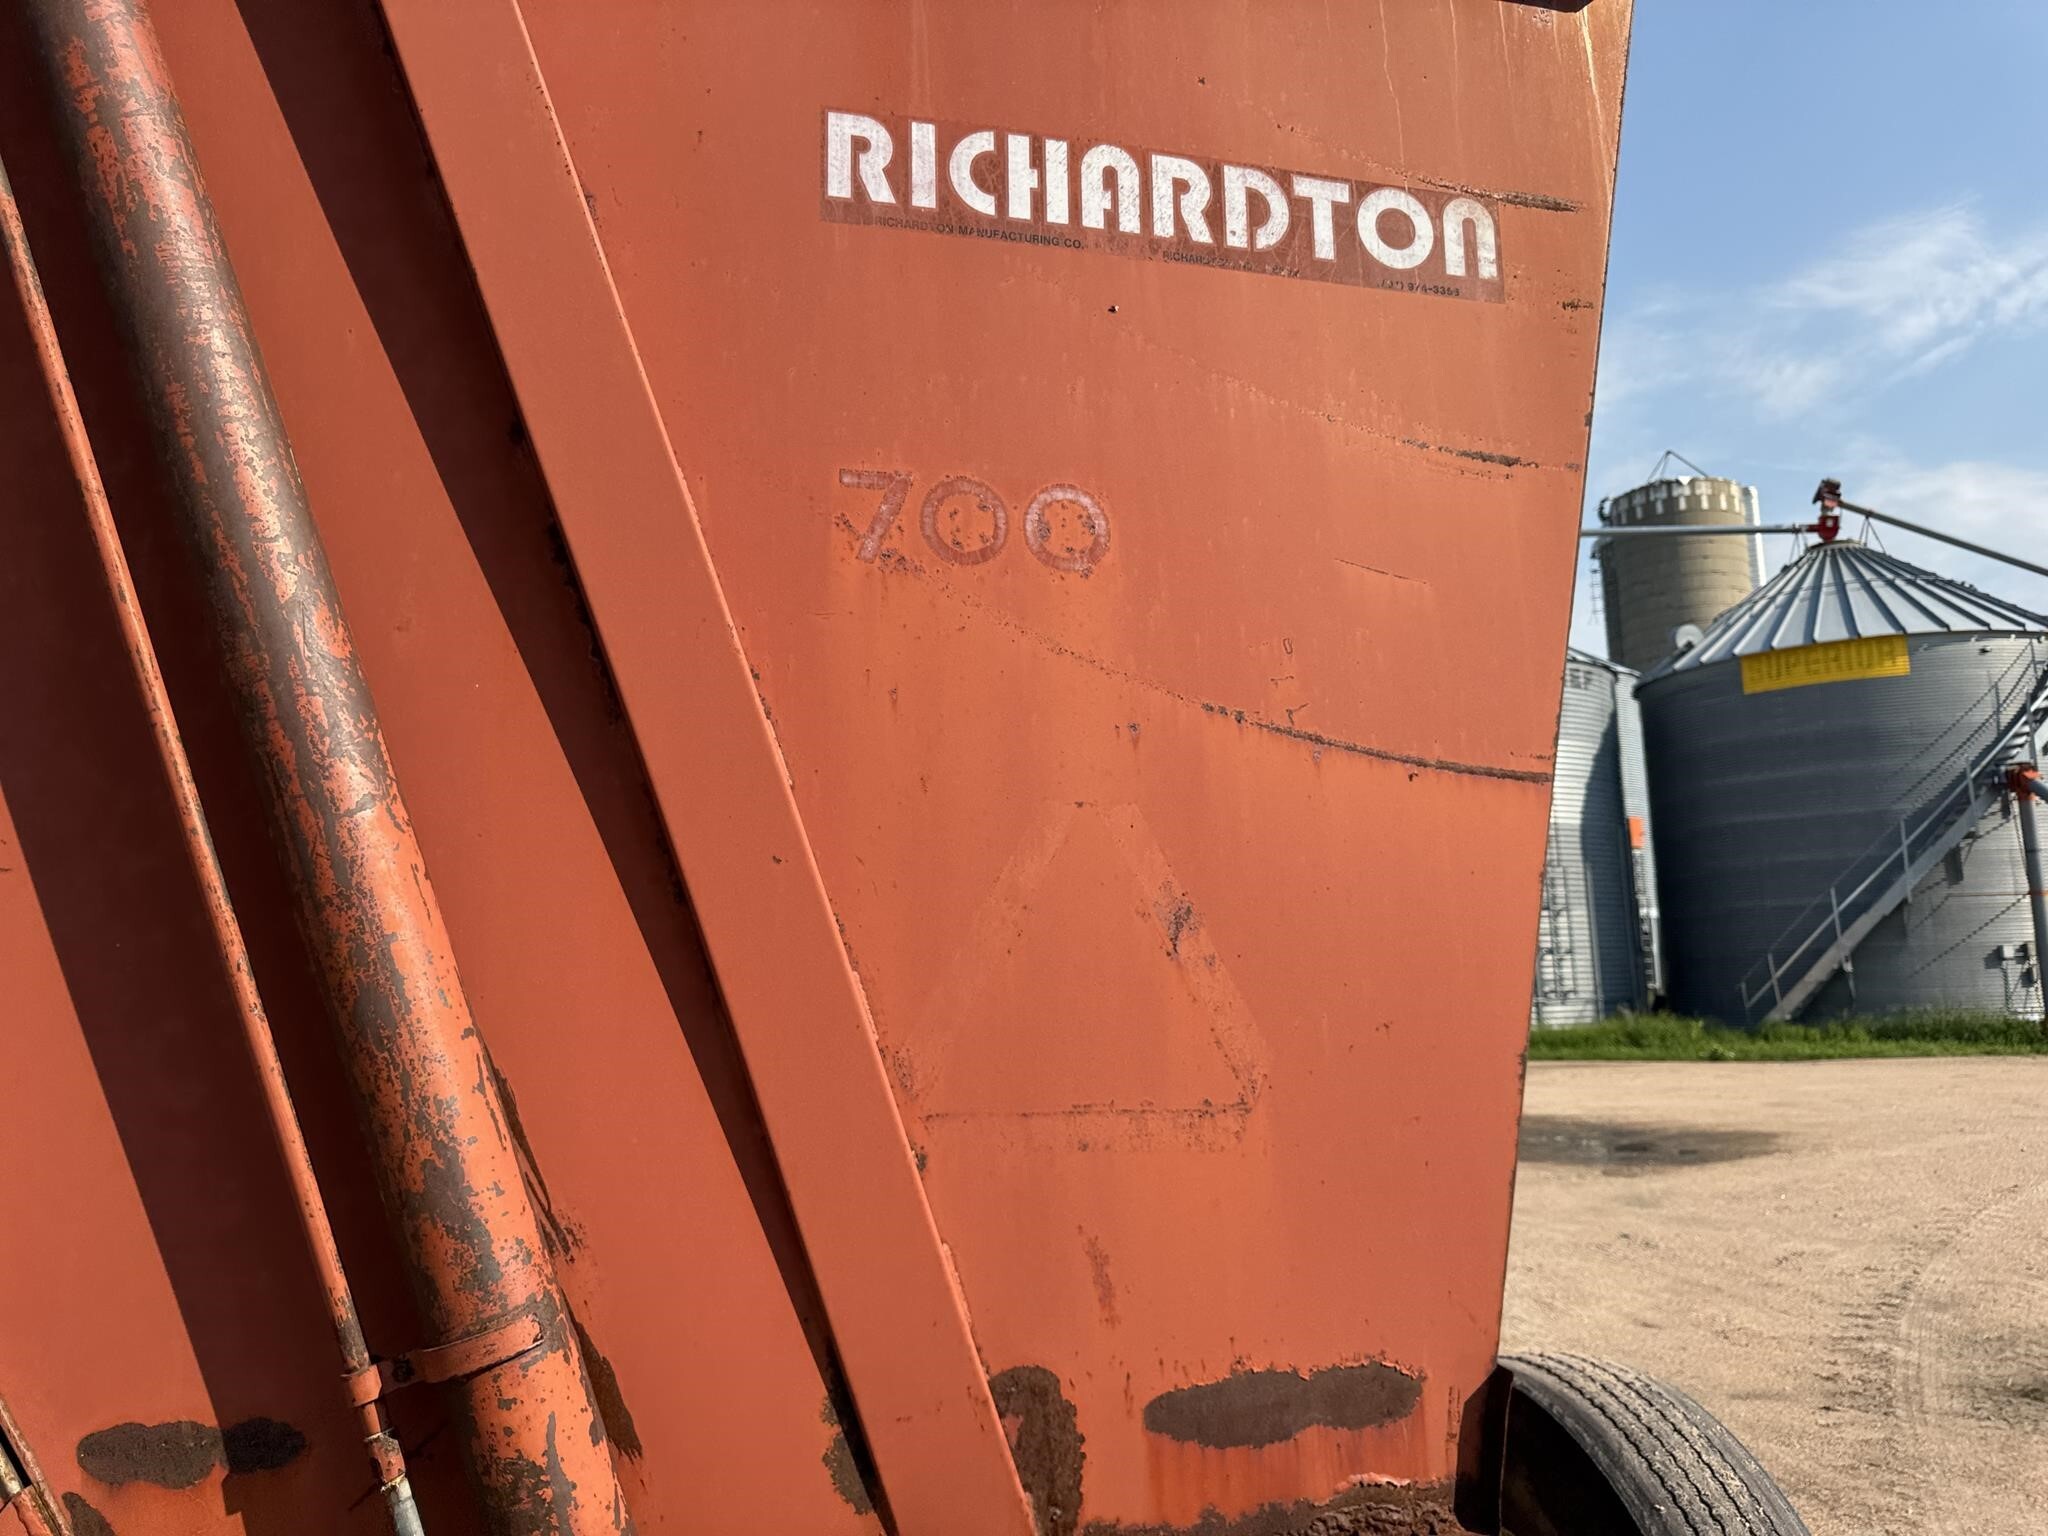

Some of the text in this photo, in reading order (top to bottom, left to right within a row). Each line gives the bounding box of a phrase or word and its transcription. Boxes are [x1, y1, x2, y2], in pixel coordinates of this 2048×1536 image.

[826, 111, 1498, 280] RICHARDTON
[958, 224, 1060, 247] MANUFACTURING
[838, 468, 1110, 571] 700
[1749, 637, 1897, 682] SUPERIOR
